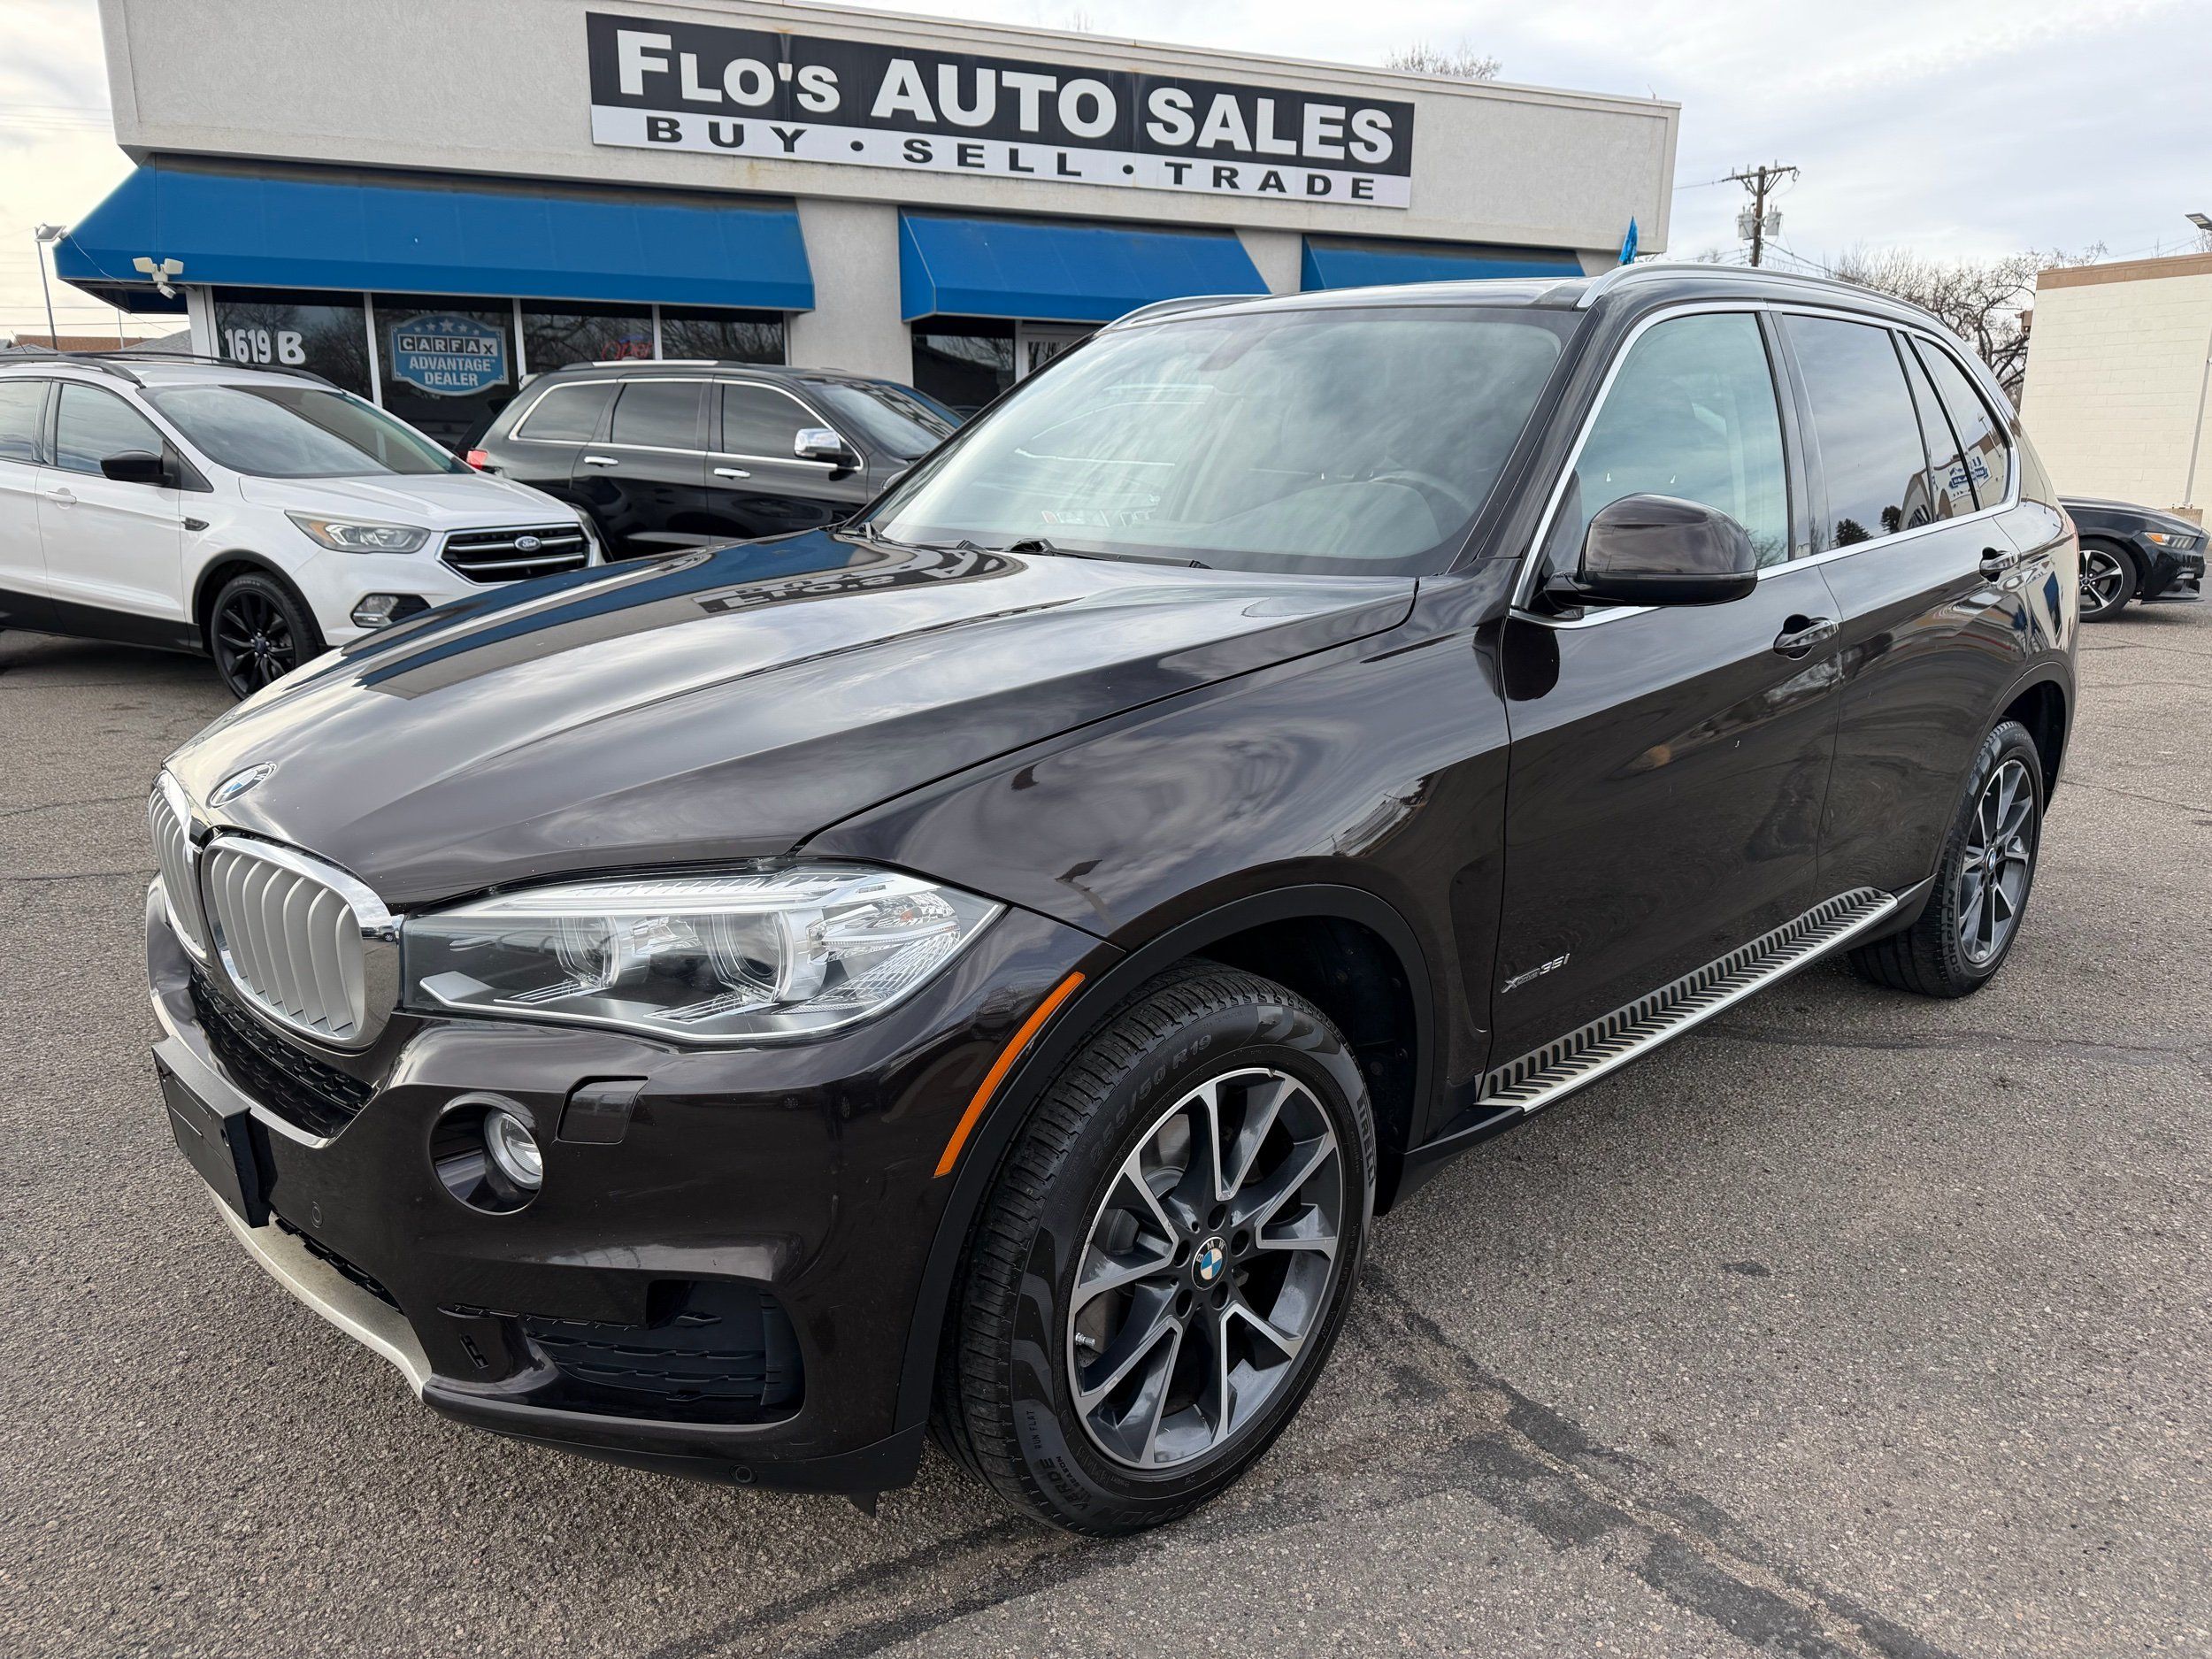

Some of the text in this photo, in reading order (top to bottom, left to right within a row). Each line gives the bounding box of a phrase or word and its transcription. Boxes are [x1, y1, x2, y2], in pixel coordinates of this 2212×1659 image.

[617, 29, 1394, 165] FLO'S AUTO SALES
[646, 116, 1375, 200] BUY SELL TRADE
[224, 328, 306, 365] 1619 B
[401, 337, 495, 355] CARFAX
[424, 372, 479, 386] DEALER
